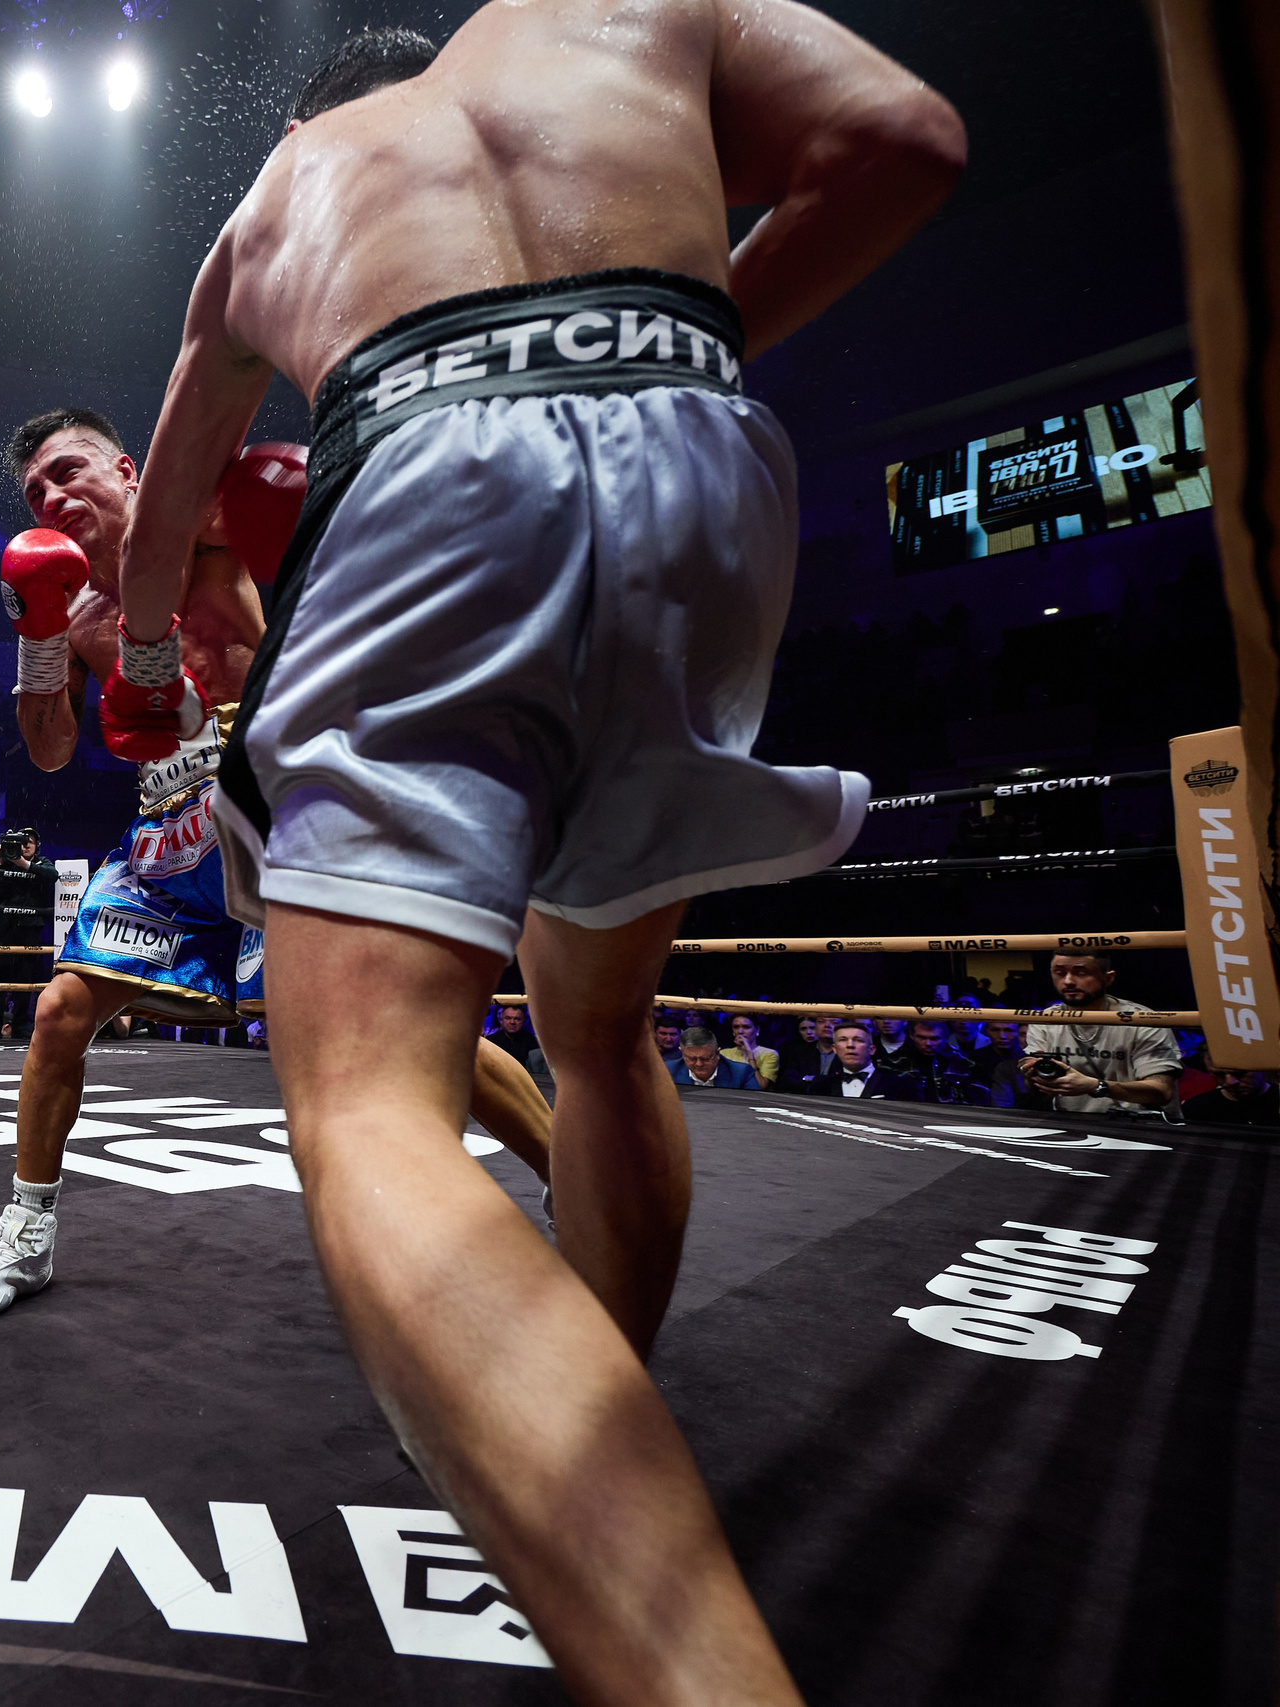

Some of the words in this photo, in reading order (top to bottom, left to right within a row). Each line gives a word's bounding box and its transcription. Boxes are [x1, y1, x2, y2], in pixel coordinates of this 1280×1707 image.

[368, 310, 743, 415] БЕТСИТИ
[989, 440, 1077, 470] БЕТСИТИ
[1188, 769, 1234, 781] БЕТСИТИ
[994, 775, 1111, 797] БЕТСИТИ
[867, 794, 936, 812] ТСИТИ
[3, 907, 36, 915] БЕТСИТИ
[104, 914, 178, 952] VILTON
[1198, 808, 1264, 1044] БЕТСИТИ
[672, 943, 702, 952] AER
[736, 943, 787, 952] РОЛЬФ
[945, 939, 1008, 950] MAER
[1058, 935, 1131, 948] РОЛЬФ
[150, 949, 169, 960] const
[892, 1220, 1159, 1361] РОЛЬФ
